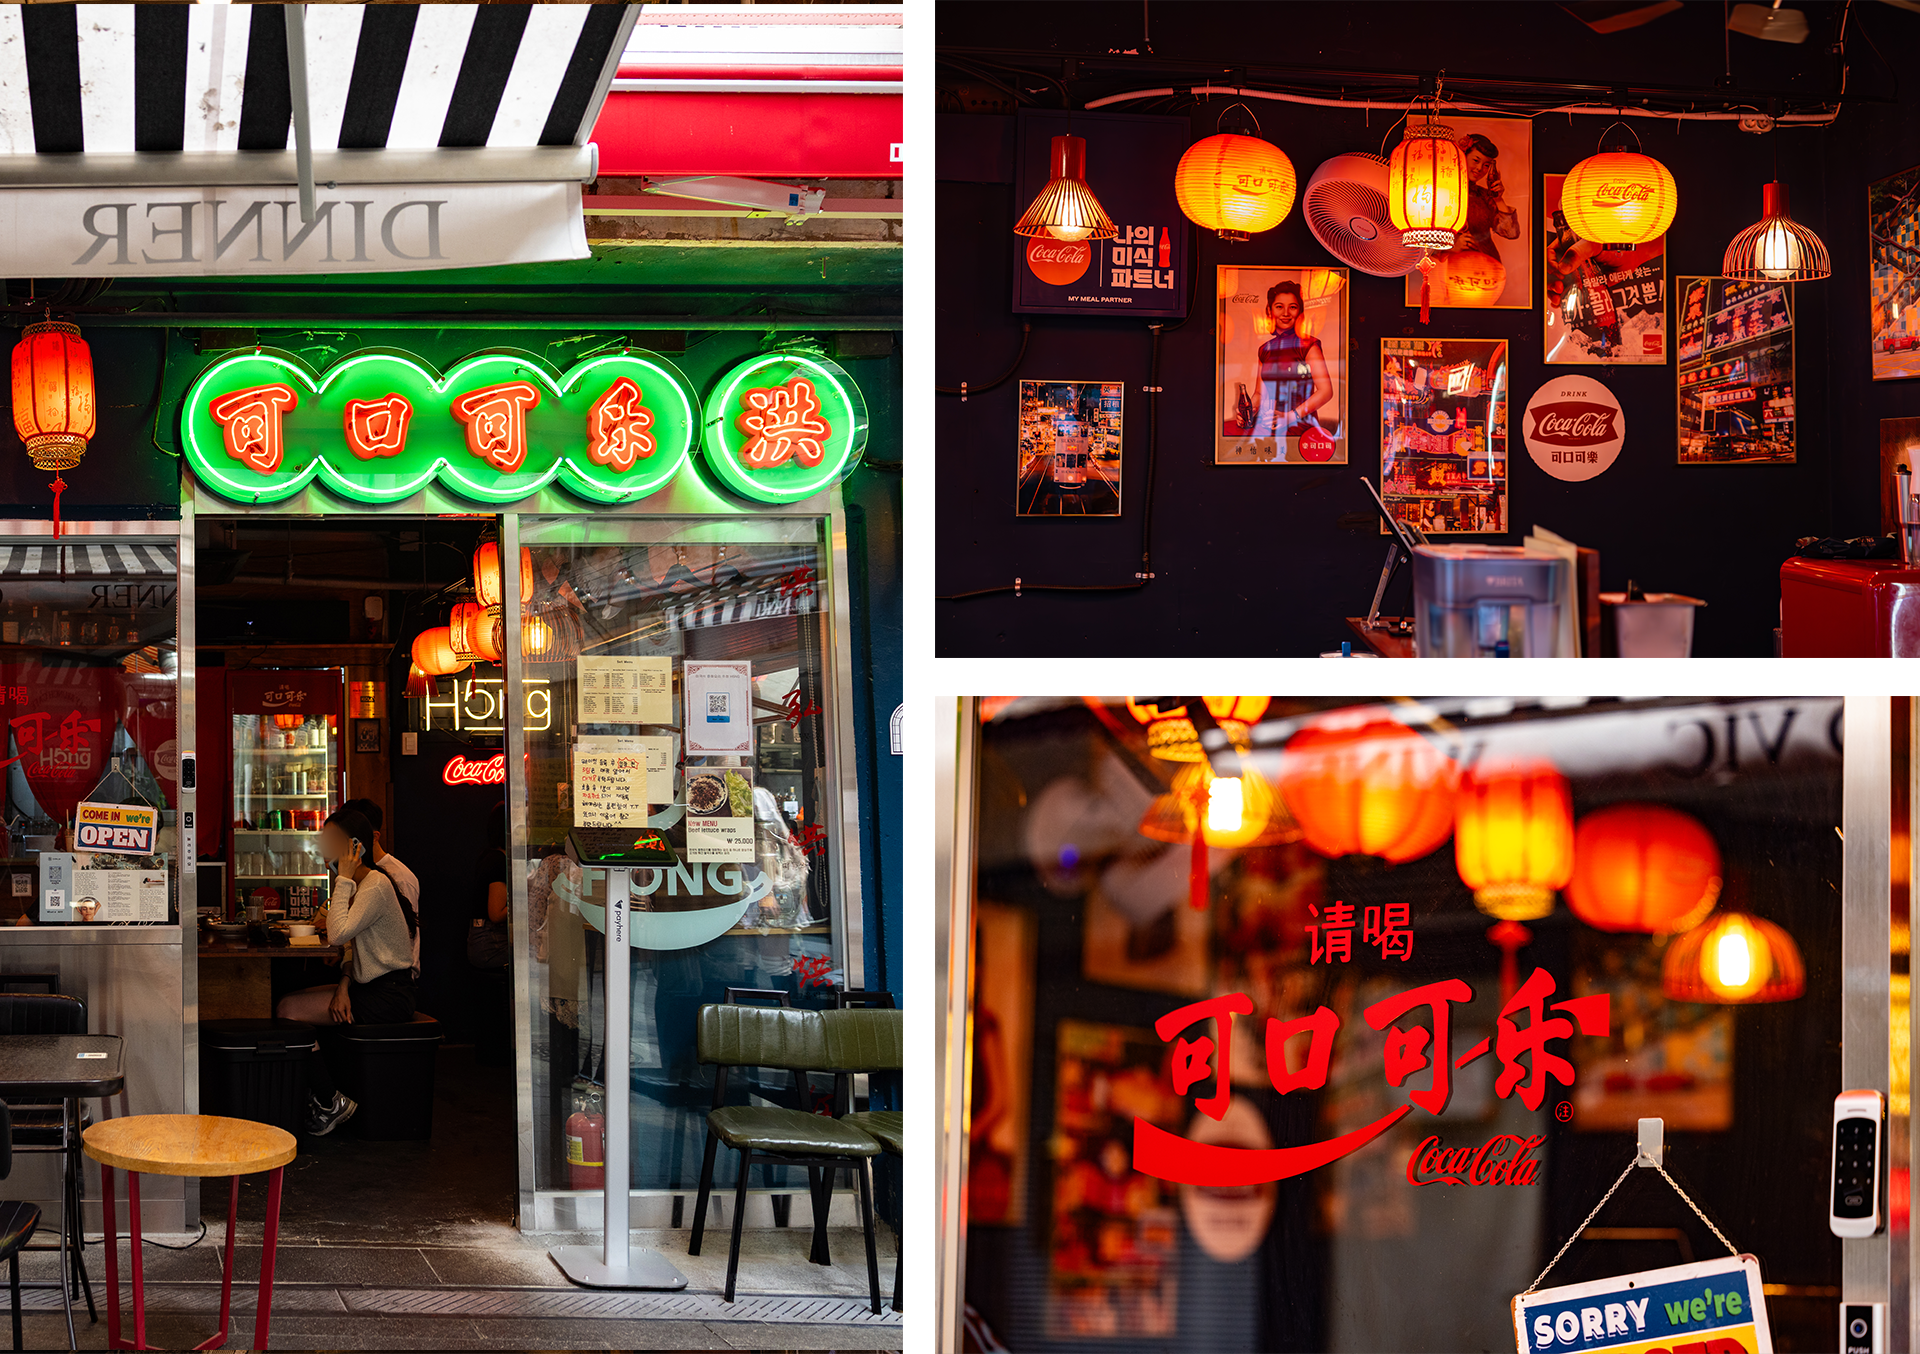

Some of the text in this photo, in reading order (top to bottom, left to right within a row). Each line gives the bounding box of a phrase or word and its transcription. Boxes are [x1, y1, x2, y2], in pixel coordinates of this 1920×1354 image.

[1112, 225, 1154, 246] 나의
[1030, 244, 1087, 264] Coca-Cola
[1112, 246, 1154, 267] 미식
[1111, 268, 1174, 290] 파트너
[1100, 296, 1132, 304] PARTNER
[209, 375, 832, 477] 可口可乐 洪
[1538, 412, 1612, 437] Coca-Cola
[1551, 451, 1598, 464] 可口可樂
[27, 761, 78, 779] Coca-Cola
[82, 809, 151, 824] COME IN we're
[80, 825, 149, 849] OPEN
[614, 910, 624, 943] payhere
[1304, 900, 1414, 965] 请喝
[1154, 966, 1611, 1122] 可口可乐
[1405, 1133, 1546, 1188] Coca-Cola
[1533, 1287, 1743, 1349] SORRY we're
